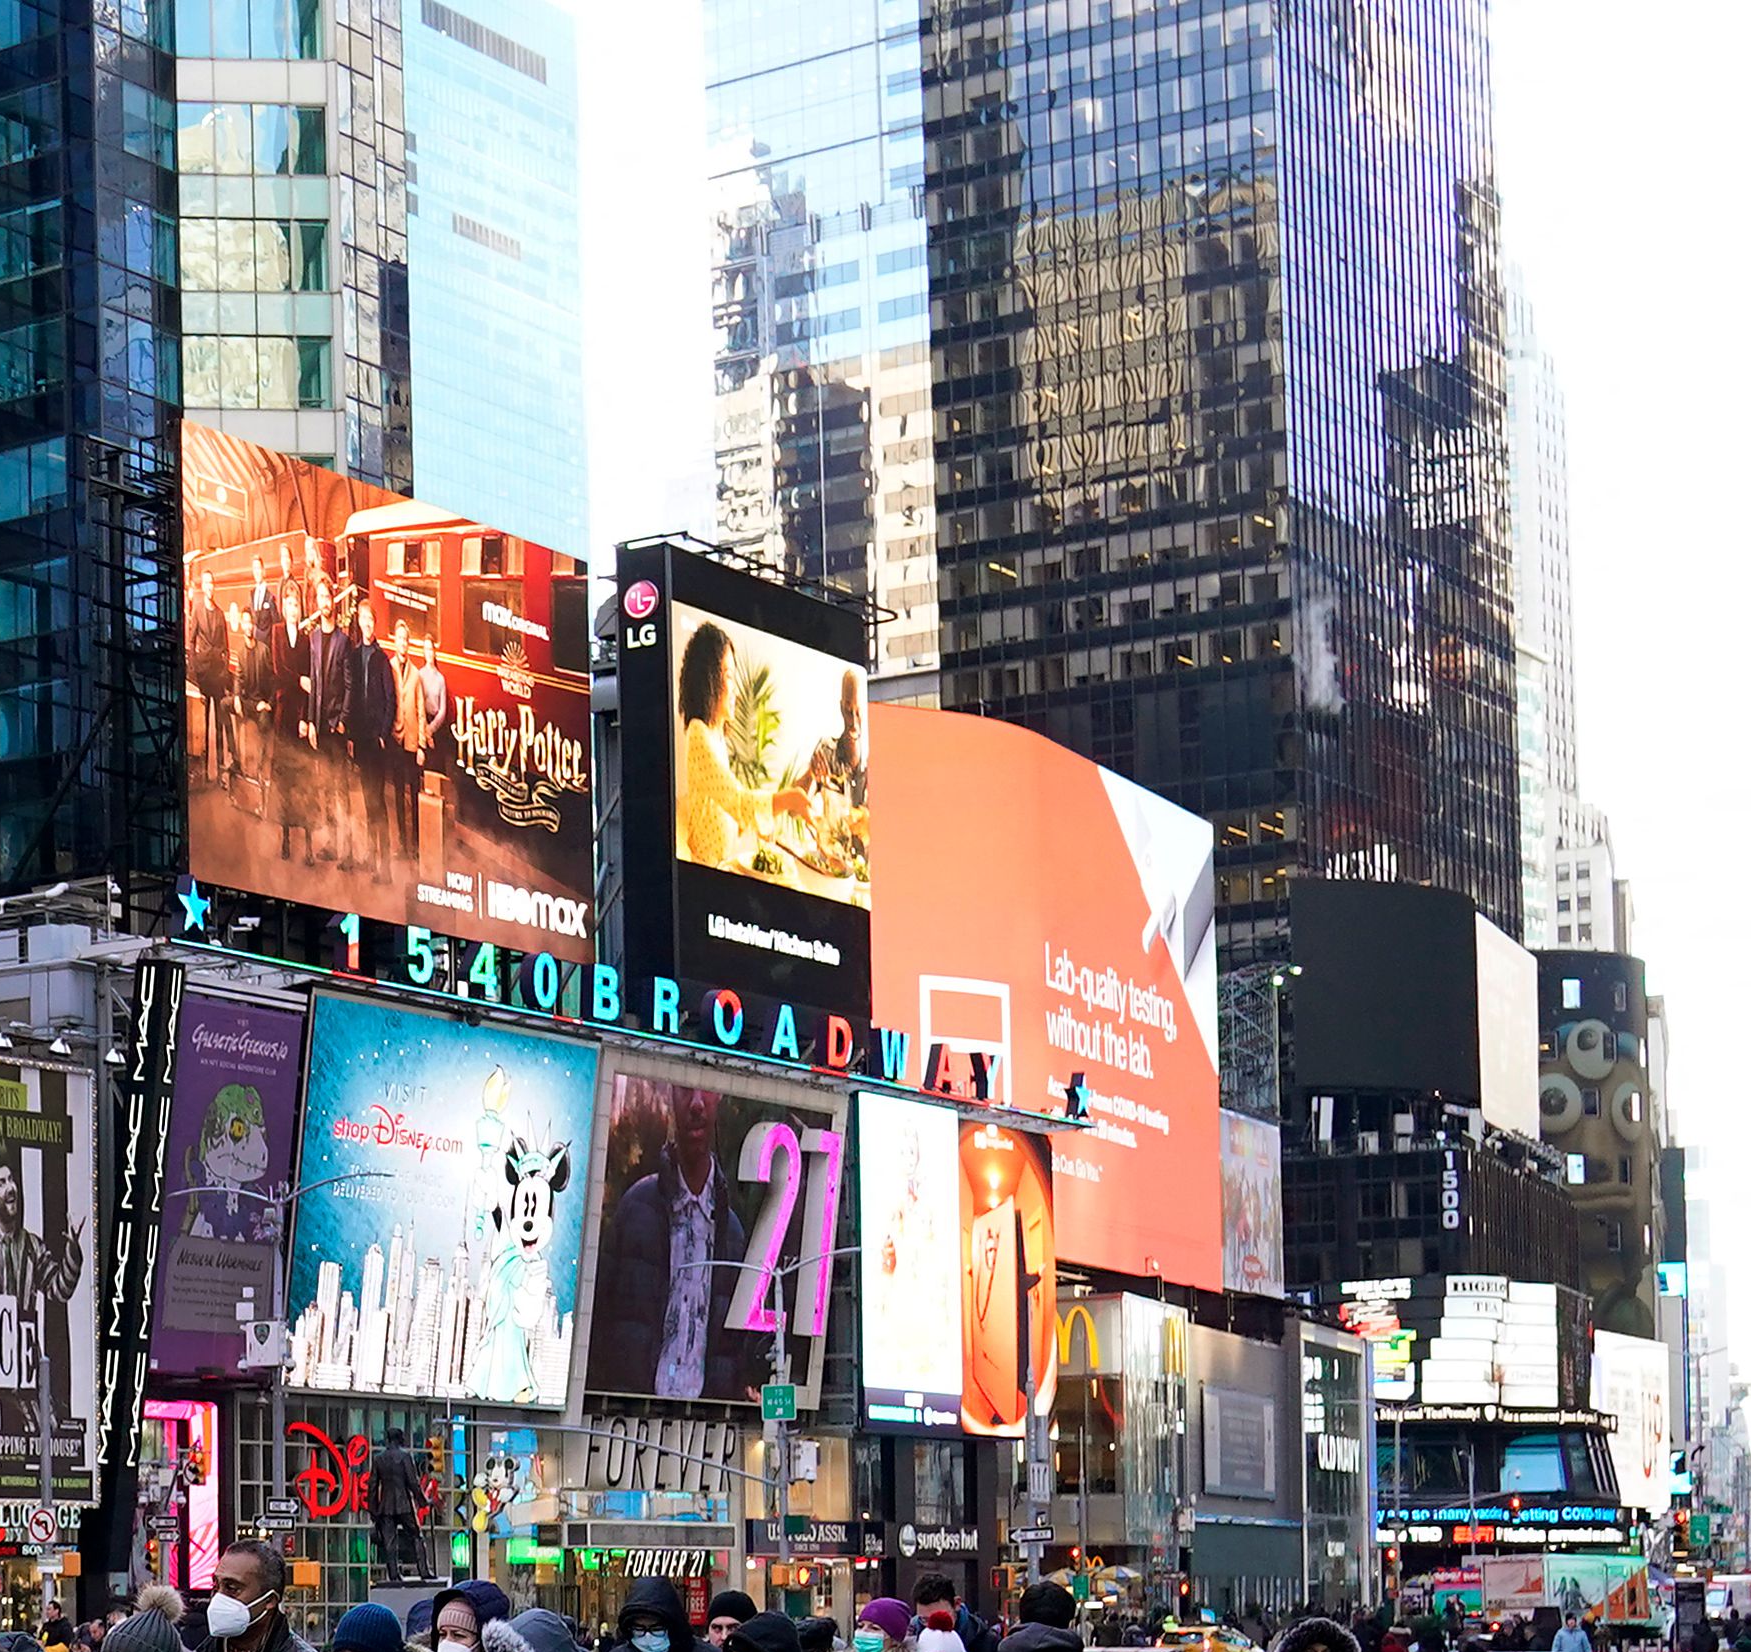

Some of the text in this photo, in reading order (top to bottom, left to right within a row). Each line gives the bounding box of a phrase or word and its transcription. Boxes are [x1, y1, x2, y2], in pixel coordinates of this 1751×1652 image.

[626, 624, 657, 649] LG
[450, 696, 588, 788] Harry Potter
[417, 882, 474, 913] STREAMING
[447, 872, 473, 893] NOW
[1044, 941, 1178, 1044] Lab-quality testing,
[1044, 1004, 1154, 1081] without the lab.
[393, 1081, 427, 1105] VISIT
[6, 1116, 63, 1145] BROADWAY!
[1441, 1150, 1459, 1230] 1500
[724, 1120, 842, 1337] 21
[584, 1414, 738, 1493] FOREVER
[1317, 1433, 1361, 1475] OLD NAVY
[815, 1522, 849, 1544] ASSN.
[916, 1526, 960, 1557] sunglass
[959, 1526, 979, 1552] hut
[623, 1550, 706, 1578] FOREVER 21
